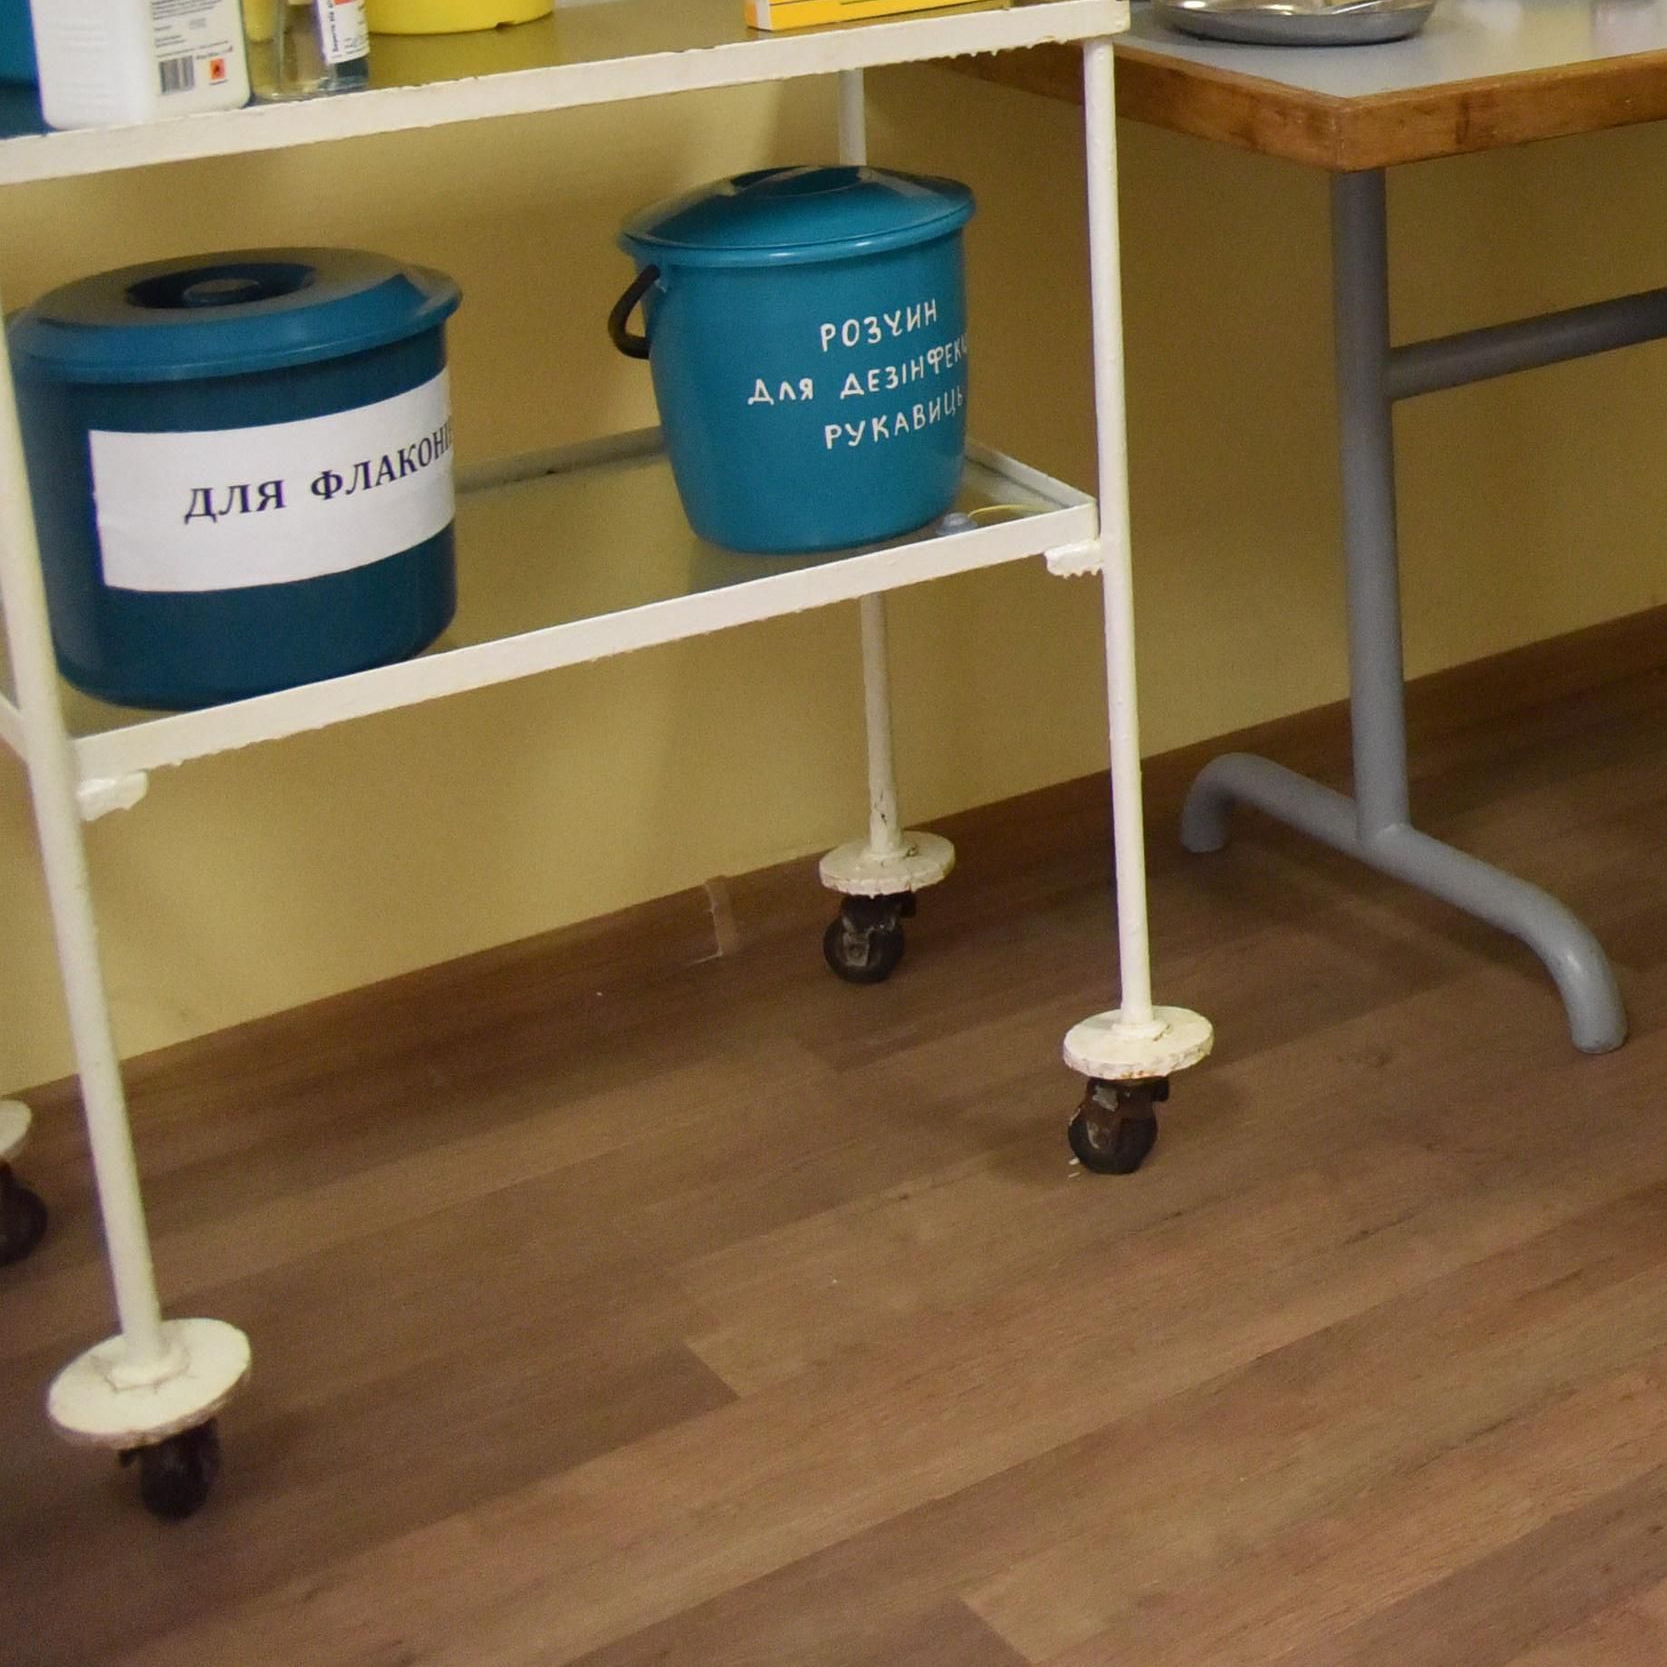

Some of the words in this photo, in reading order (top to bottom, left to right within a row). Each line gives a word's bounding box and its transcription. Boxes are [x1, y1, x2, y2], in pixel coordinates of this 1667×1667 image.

[820, 298, 937, 352] РОЗЧИН
[824, 385, 964, 450] РУКАВИЦЬ
[184, 479, 287, 525] ДЛЯ
